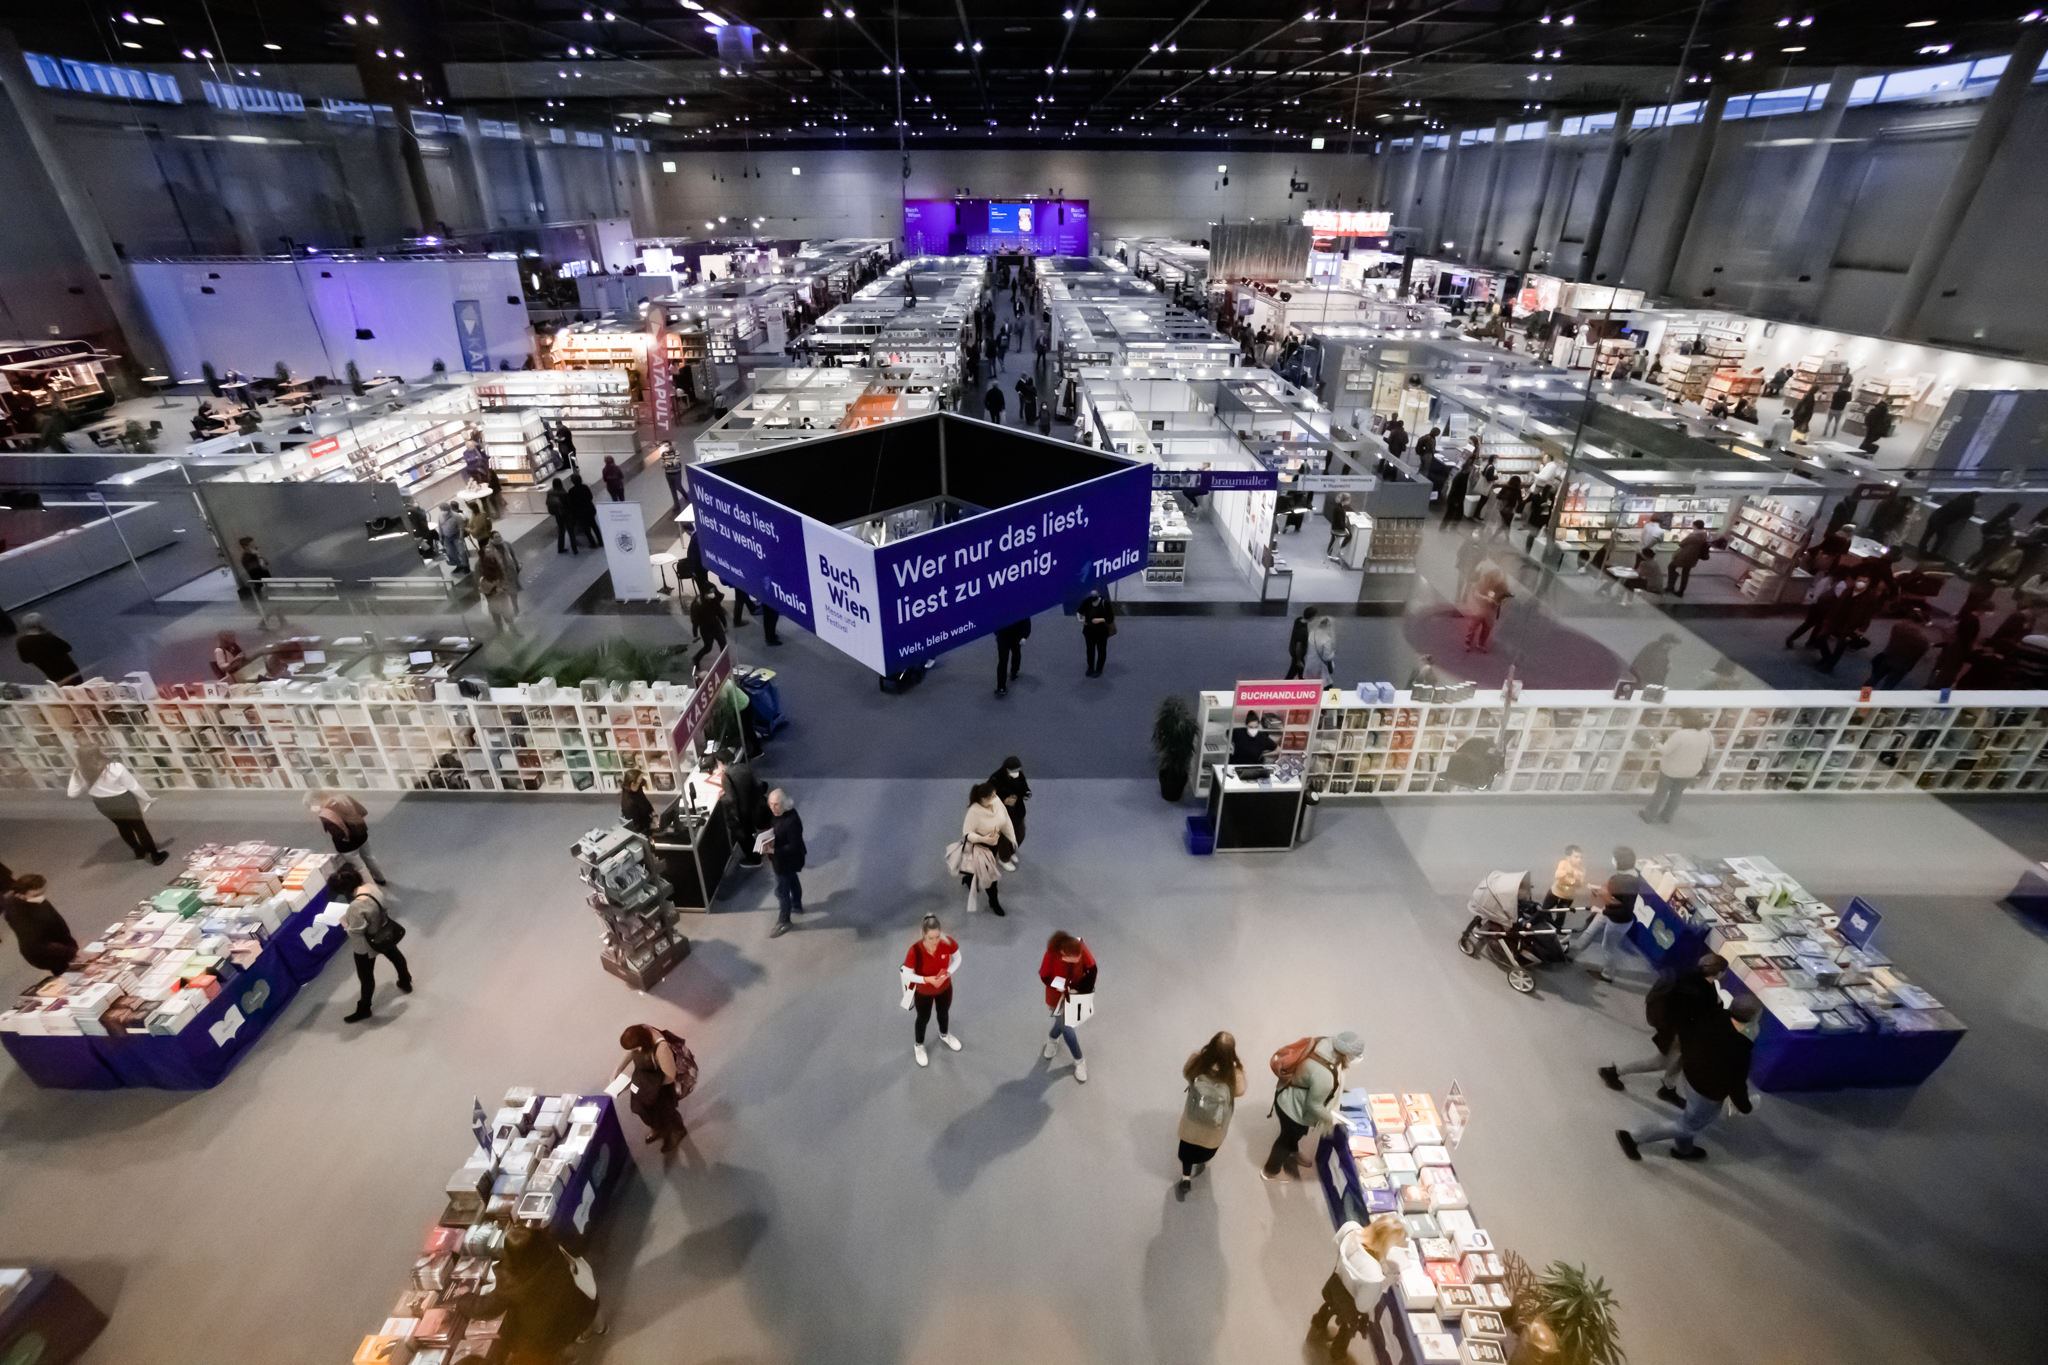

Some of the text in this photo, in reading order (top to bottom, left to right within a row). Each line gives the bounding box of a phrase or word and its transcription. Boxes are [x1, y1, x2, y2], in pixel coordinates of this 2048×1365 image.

[652, 352, 669, 431] ATAPULT
[1211, 475, 1269, 486] braumüller
[694, 483, 779, 542] Wer nur das liest,
[698, 508, 766, 559] liest zu wenig.
[892, 504, 1089, 588] Wer nur das liest,
[819, 554, 860, 594] Buch
[1093, 548, 1140, 578] Thalia
[771, 581, 807, 614] Thalia
[827, 582, 870, 623] Wien
[897, 550, 1057, 624] liest zu wenig.
[825, 604, 856, 628] Messe und
[826, 615, 848, 633] Festival
[898, 620, 976, 658] Welt, bleib wach.
[686, 672, 720, 733] KASSA
[1240, 690, 1316, 700] BUCHHANDLUNG
